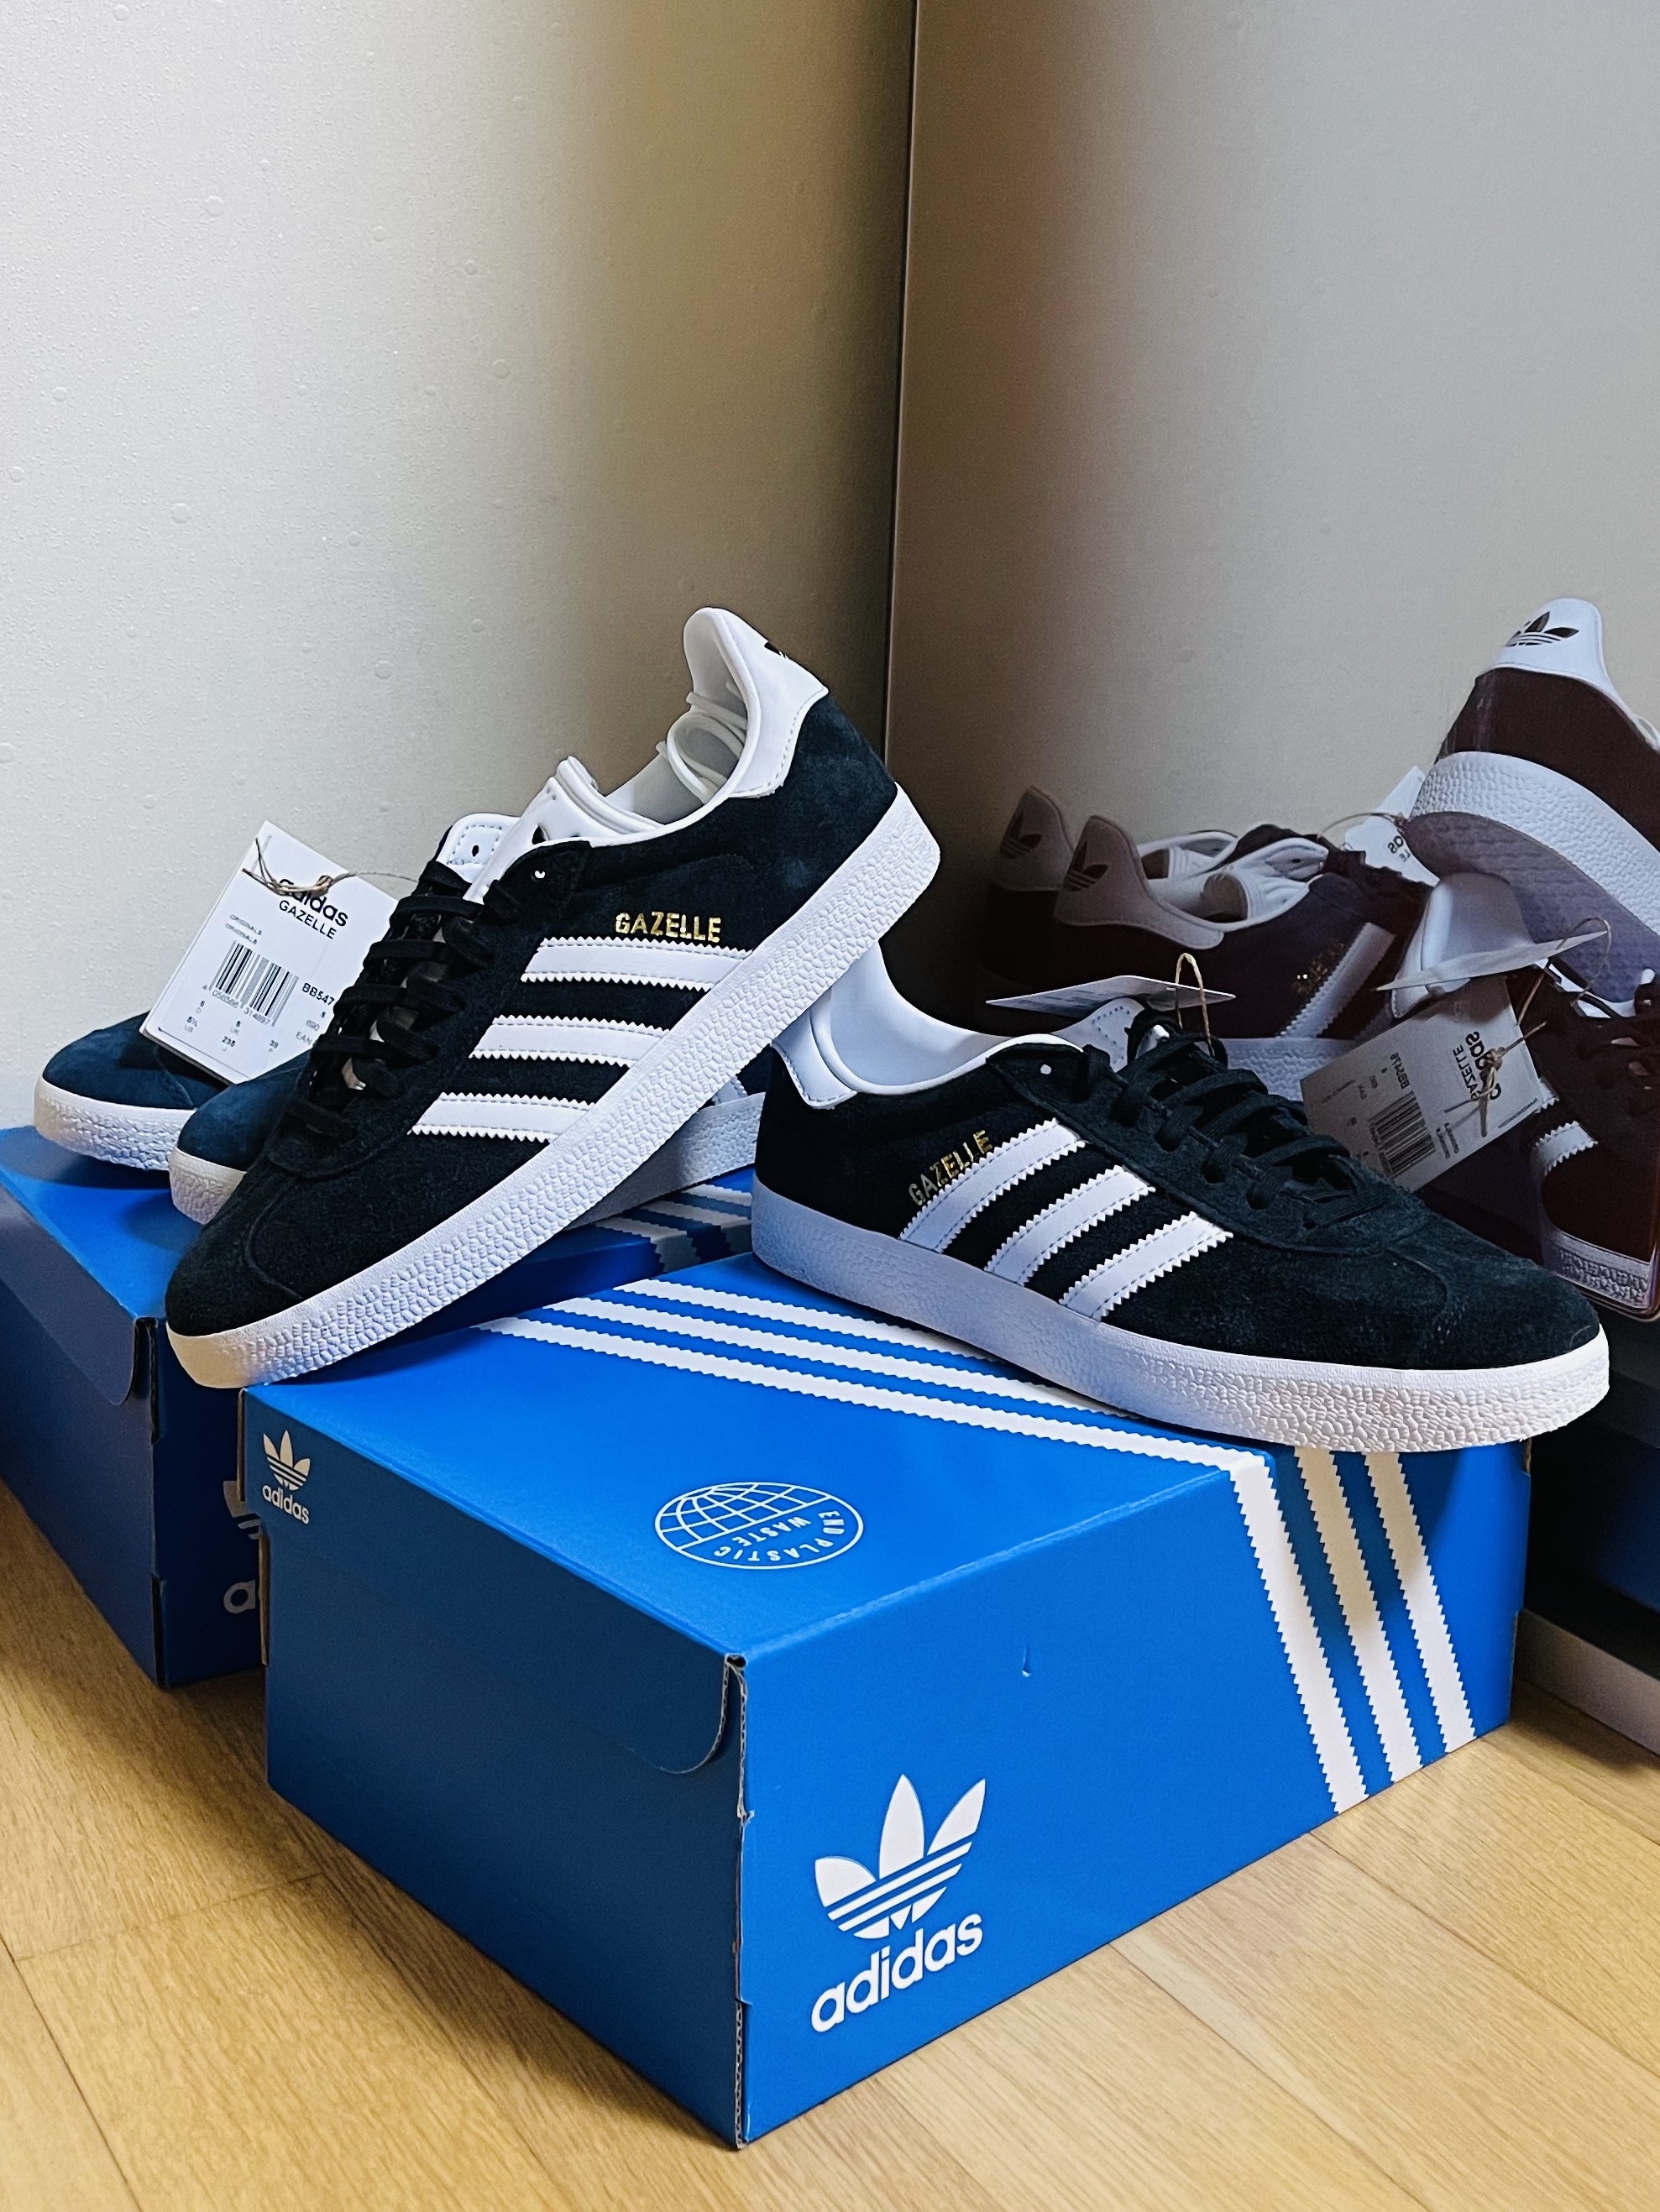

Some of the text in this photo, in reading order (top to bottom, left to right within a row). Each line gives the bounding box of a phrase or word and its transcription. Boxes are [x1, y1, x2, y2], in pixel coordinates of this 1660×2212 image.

[279, 901, 338, 940] GAZELLE
[615, 911, 721, 944] GAZELLE
[909, 1129, 993, 1206] GAZELLE
[261, 1483, 310, 1526] adidas
[714, 1510, 845, 1562] END PLASTIC
[732, 1516, 812, 1548] WASTE
[810, 1912, 984, 2033] adidas
